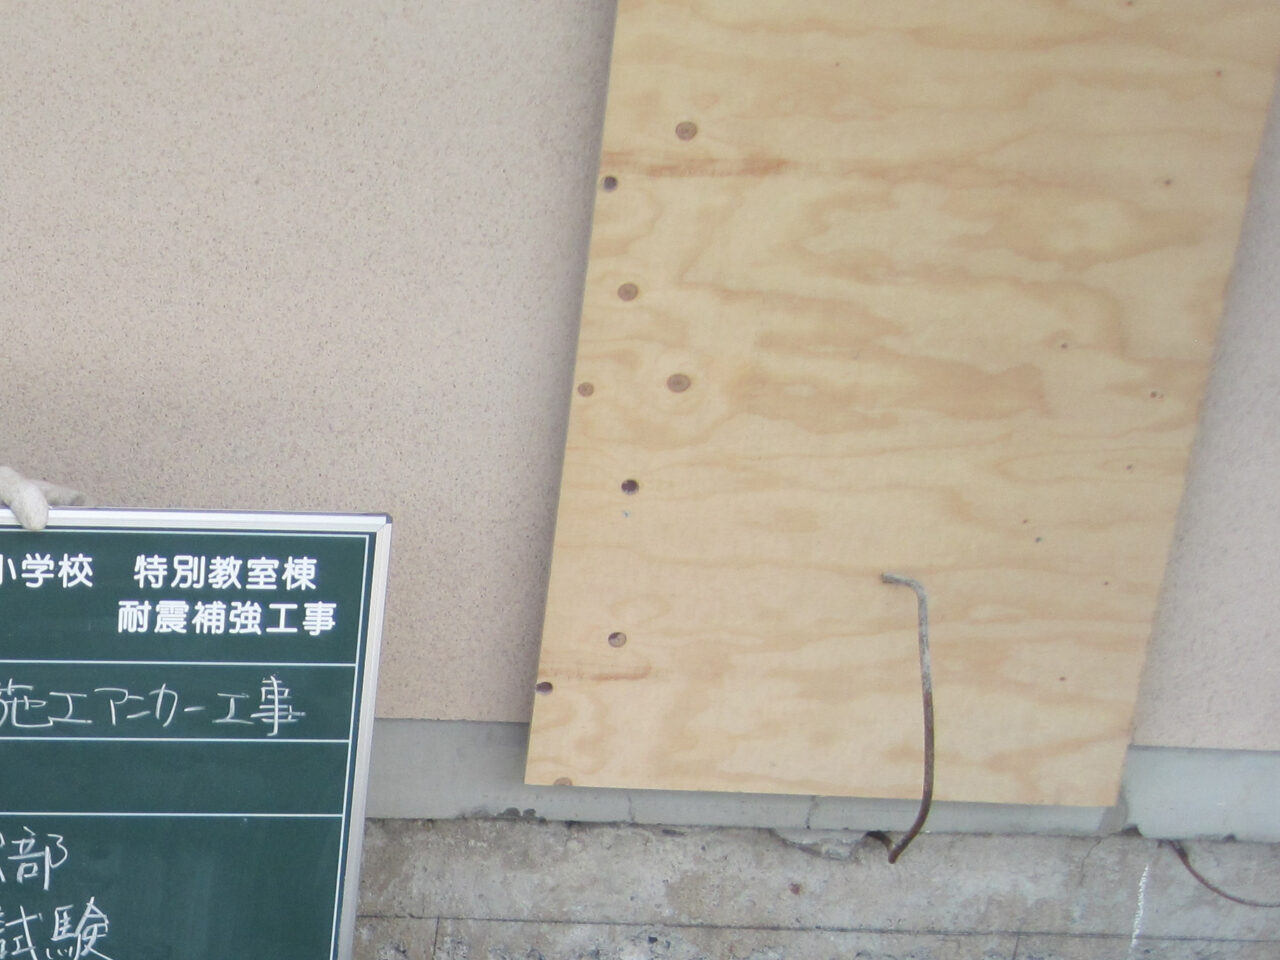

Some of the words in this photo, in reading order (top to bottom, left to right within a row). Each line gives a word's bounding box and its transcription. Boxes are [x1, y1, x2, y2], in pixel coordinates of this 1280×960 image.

[132, 553, 318, 591] 特別教室棟
[117, 599, 338, 637] 耐震補強工事
